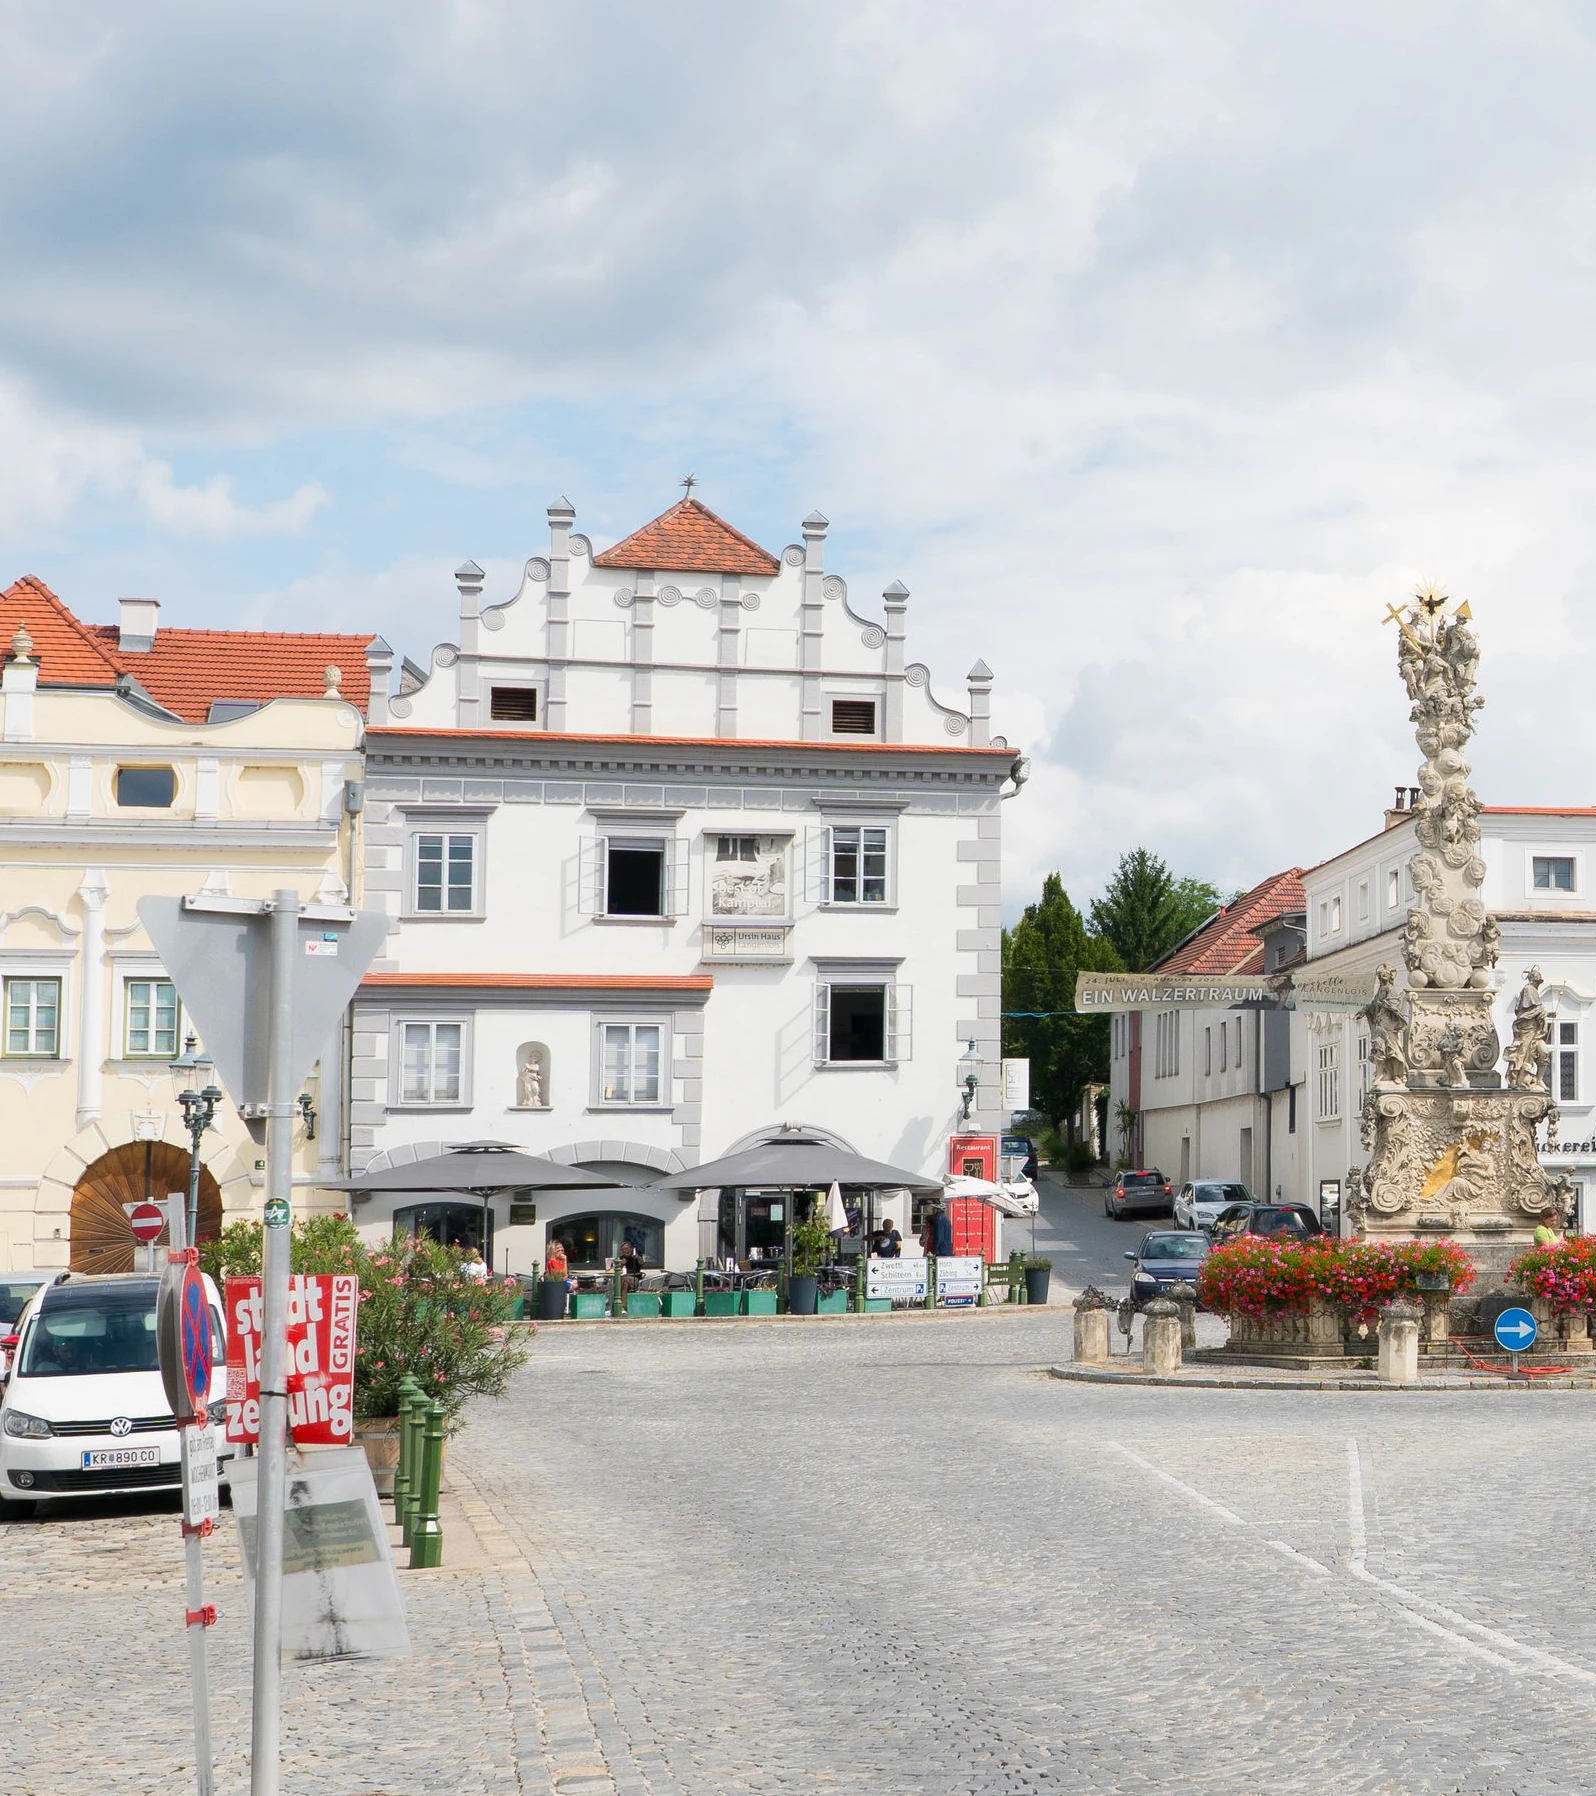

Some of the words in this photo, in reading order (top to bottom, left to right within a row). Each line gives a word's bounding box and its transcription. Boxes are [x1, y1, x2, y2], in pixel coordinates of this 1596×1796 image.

[738, 932, 759, 940] Ursin
[761, 932, 781, 940] Haus
[1300, 986, 1368, 996] LANGENLOIS
[1082, 988, 1114, 1005] EIN
[1121, 987, 1263, 1003] WALZERTRAUM
[880, 1261, 904, 1270] Zwettl
[880, 1271, 912, 1279] Schiltern
[884, 1286, 914, 1294] Zentrum
[947, 1283, 971, 1292] Zentrum
[235, 1274, 324, 1336] stdt
[332, 1279, 352, 1370] GRATIS
[92, 1453, 107, 1465] KR
[116, 1451, 138, 1463] 890
